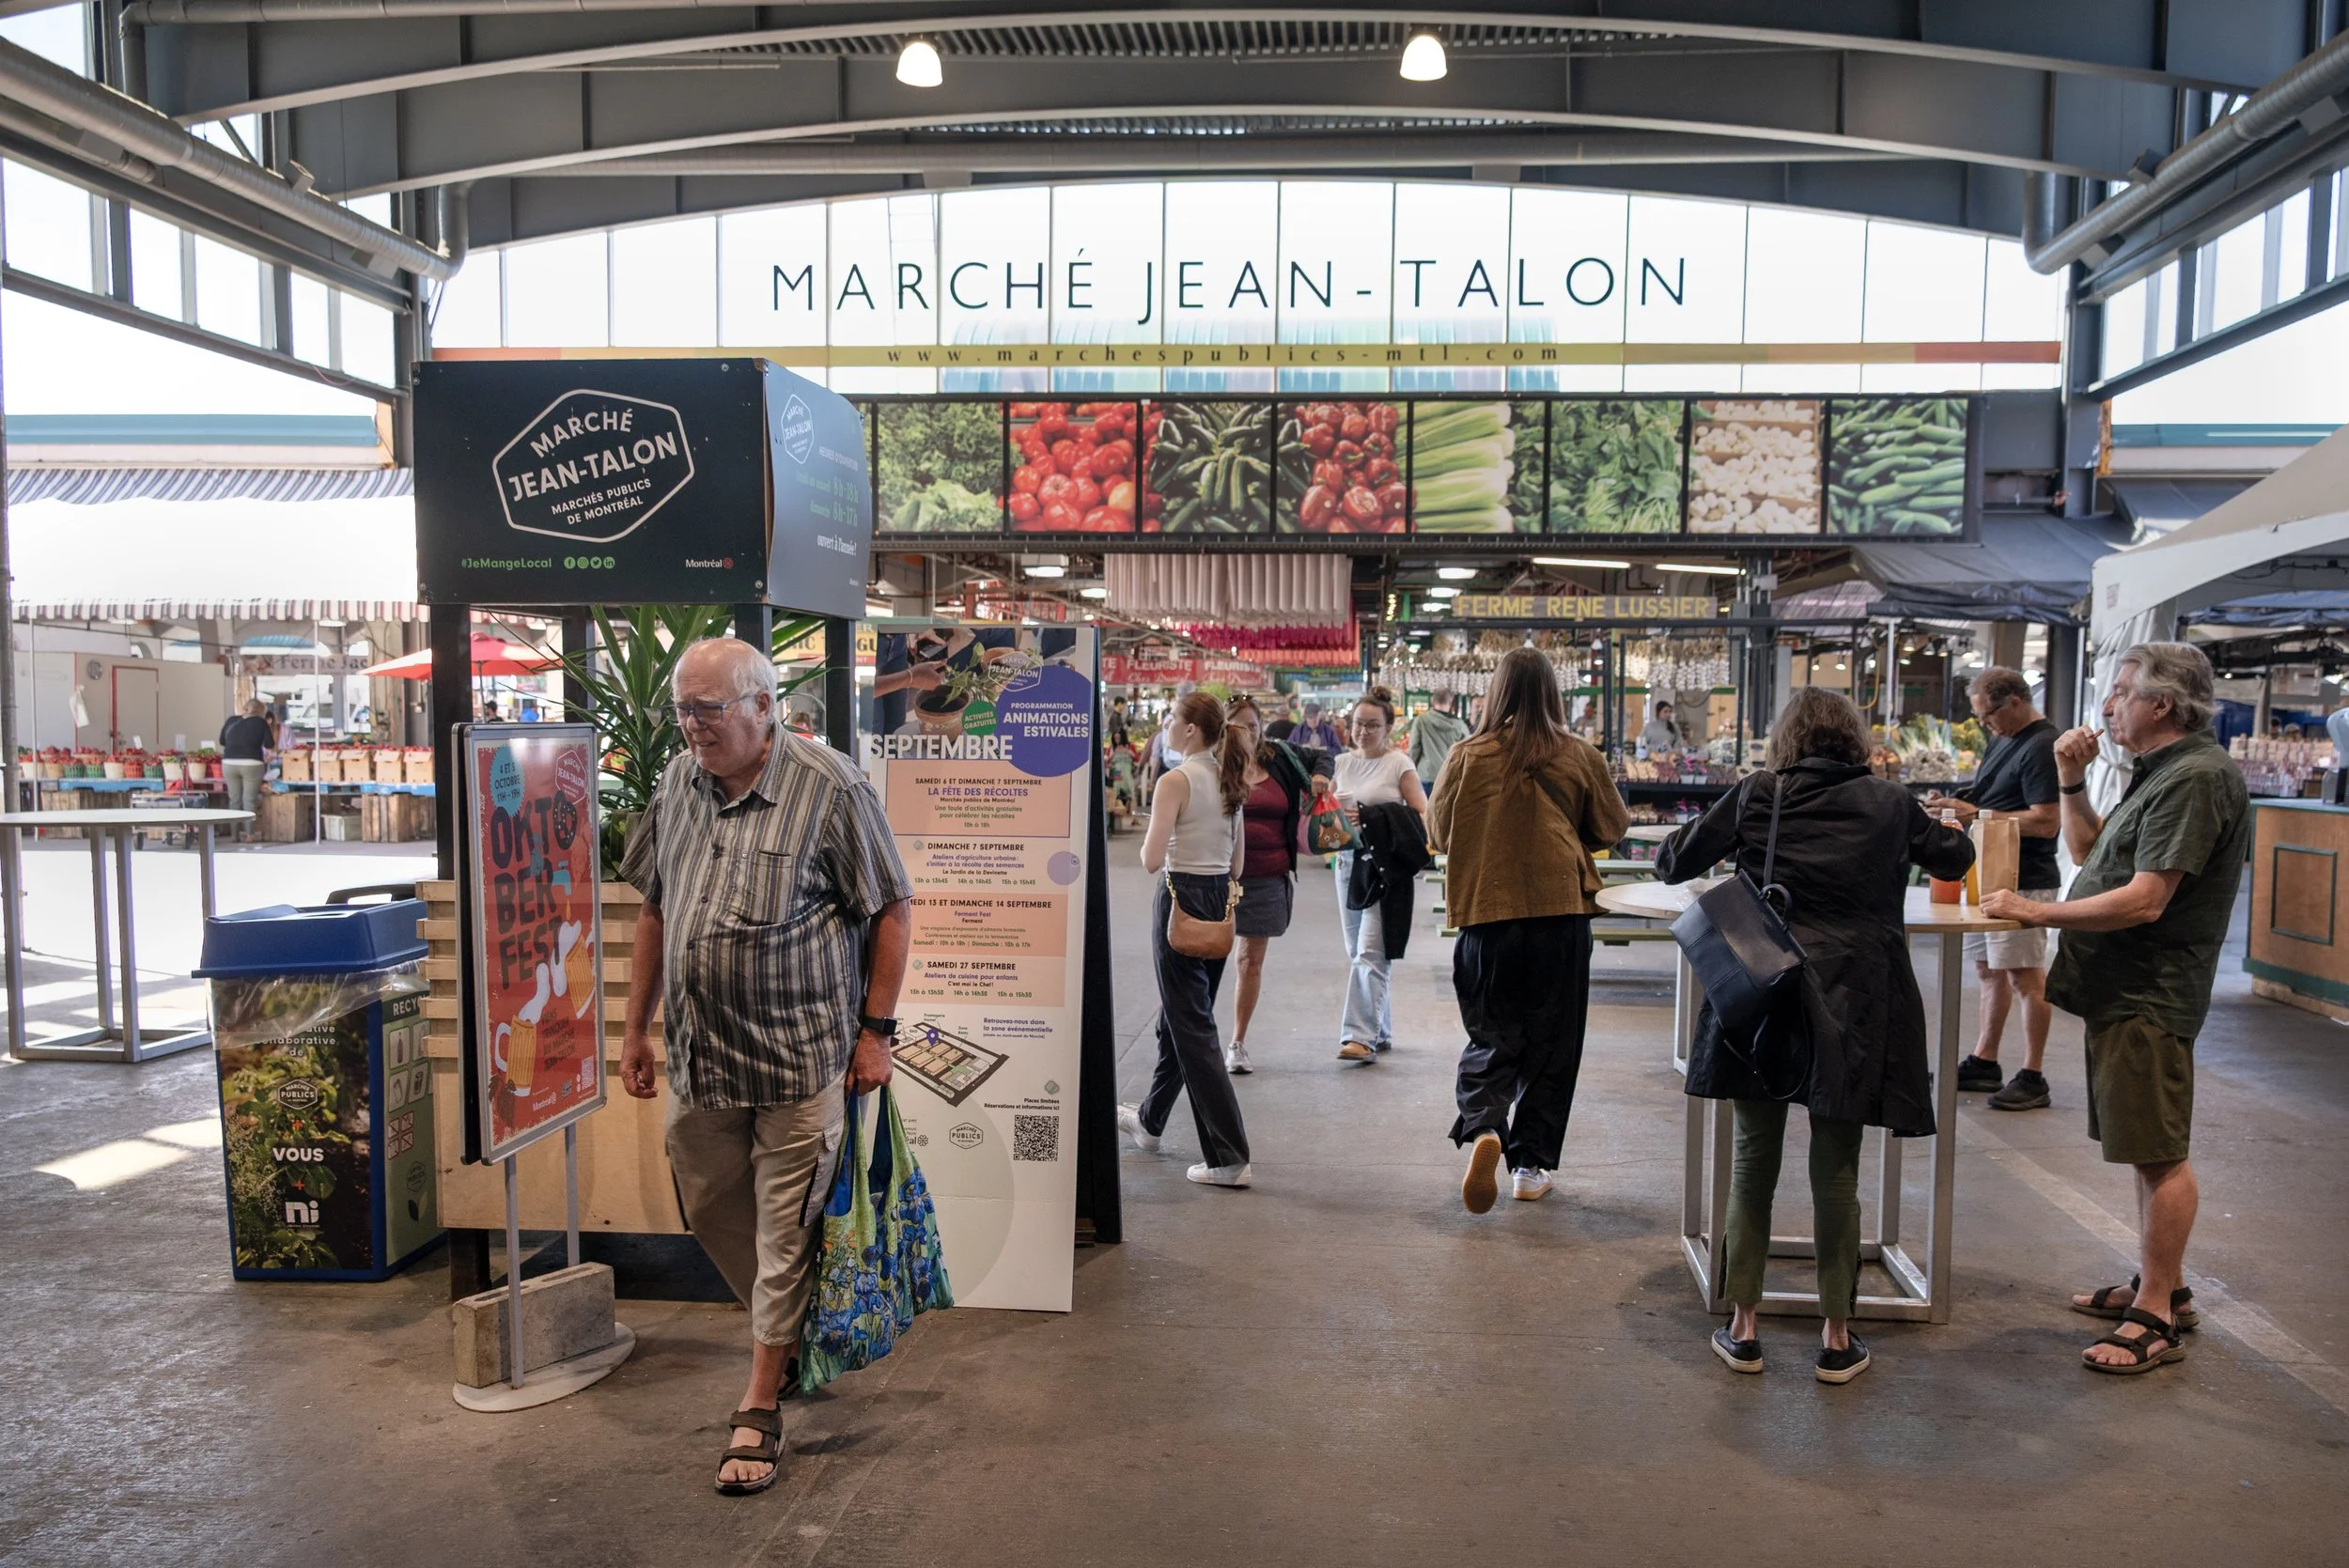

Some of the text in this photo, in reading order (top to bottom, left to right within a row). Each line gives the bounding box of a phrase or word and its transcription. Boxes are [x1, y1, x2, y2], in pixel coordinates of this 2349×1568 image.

[772, 248, 1094, 310] MARCHÉ
[530, 409, 632, 458] MARCHÉ
[508, 432, 677, 502] JEAN-TALON
[552, 478, 651, 515] MARCHÉS PUBLICS
[567, 496, 643, 525] DE MONTRÉAL
[461, 558, 552, 569] #JeMangeLocal
[686, 559, 722, 567] Montréal
[1458, 596, 1533, 616] FERME
[1614, 598, 1710, 617] LUSSIER
[964, 719, 997, 729] GRATUITES
[1003, 713, 1089, 723] ANIMATIONS
[1024, 726, 1089, 737] ESTIVALES
[871, 734, 1013, 760] SEPTEMBRE
[495, 775, 521, 789] OCTOBRE
[942, 785, 961, 795] FÊTE
[985, 786, 1028, 796] RÉCOLTES
[494, 857, 556, 935] BER
[499, 915, 563, 990] FEST
[289, 1048, 303, 1056] de
[272, 1148, 324, 1162] VOUS
